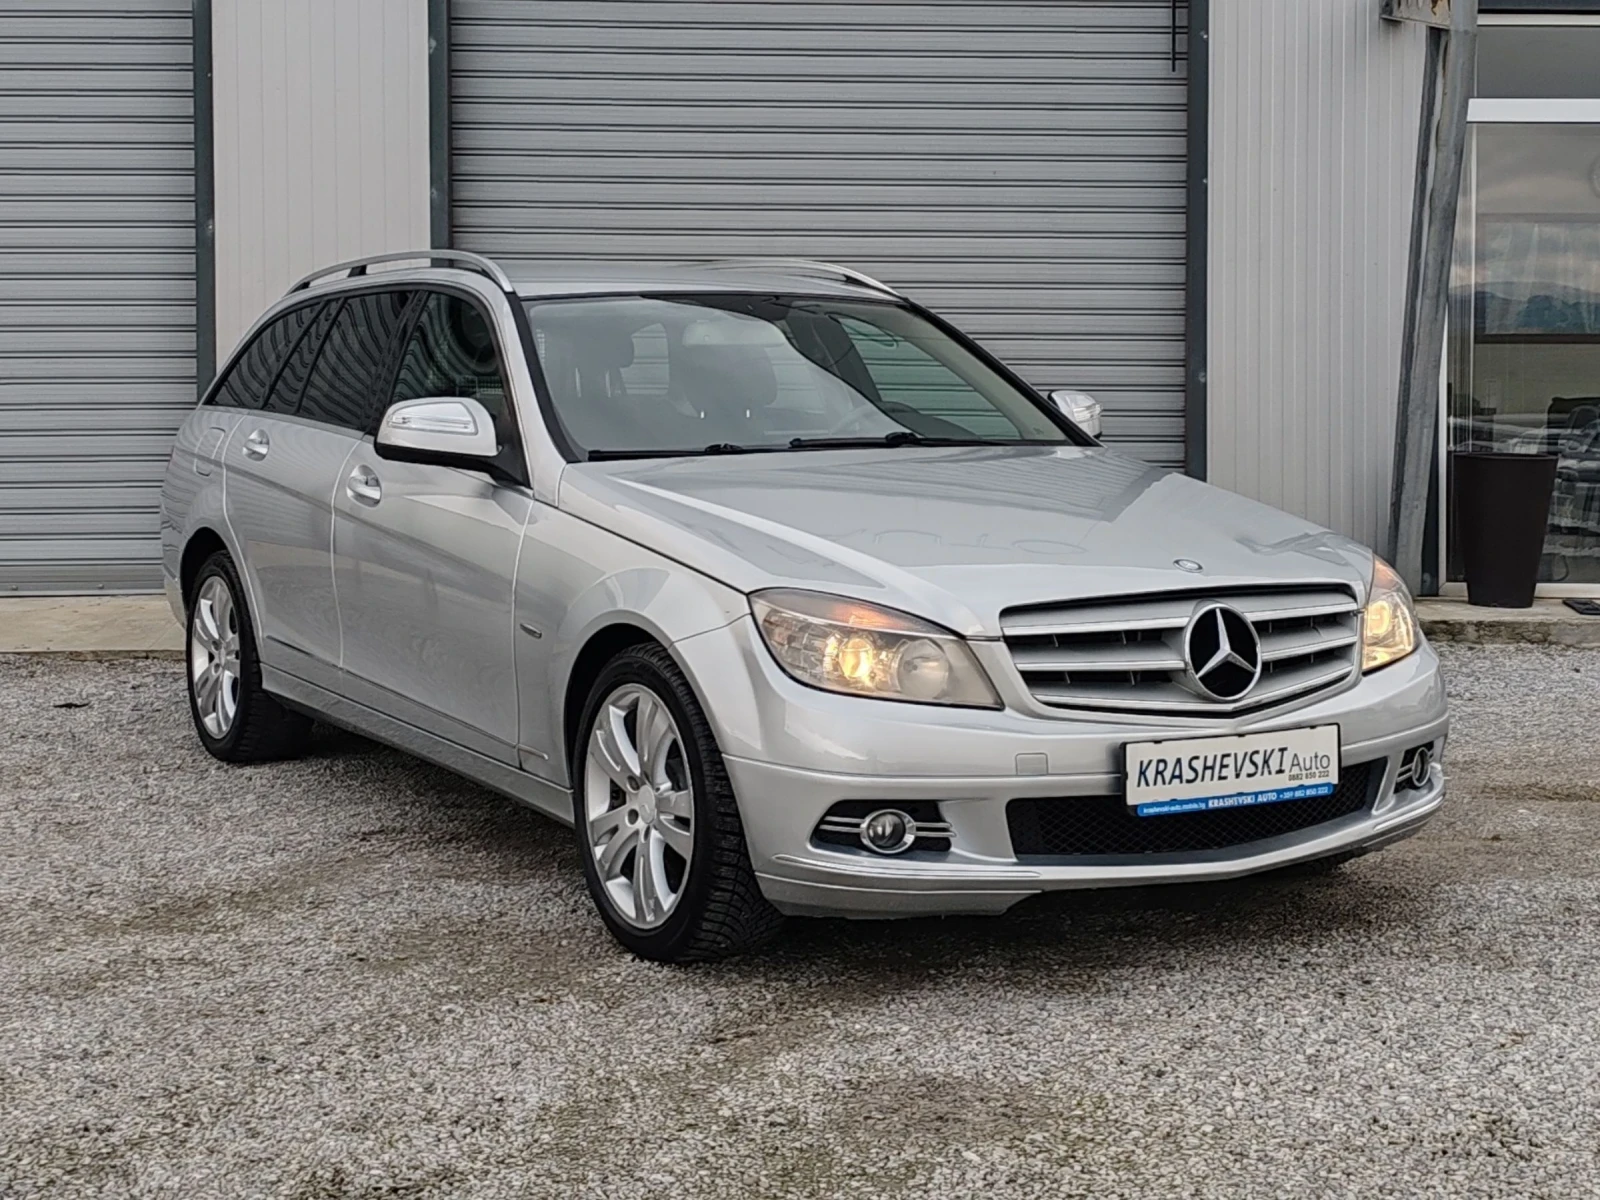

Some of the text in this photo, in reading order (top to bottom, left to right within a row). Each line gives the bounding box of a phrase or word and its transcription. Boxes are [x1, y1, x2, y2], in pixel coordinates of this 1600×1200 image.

[1137, 747, 1330, 787] KRASHEVSKI Auto
[1288, 770, 1329, 781] 0882 850 222
[1257, 792, 1277, 802] AUTO
[1318, 786, 1328, 794] 222
